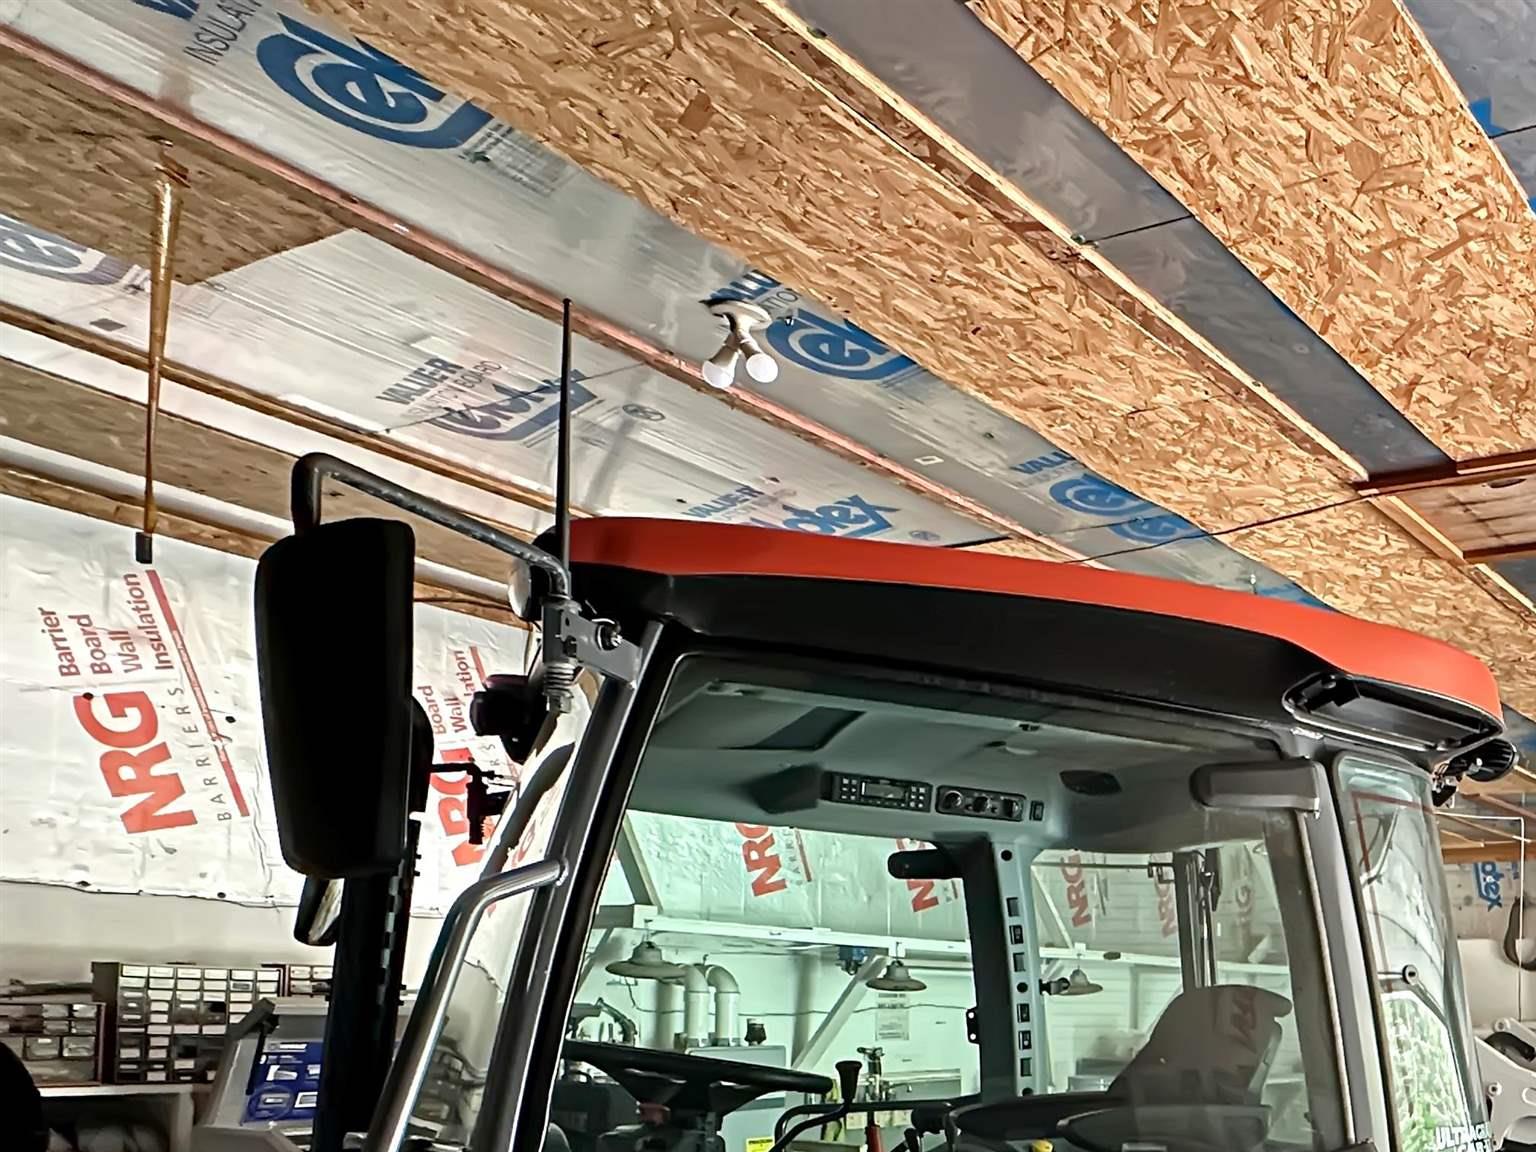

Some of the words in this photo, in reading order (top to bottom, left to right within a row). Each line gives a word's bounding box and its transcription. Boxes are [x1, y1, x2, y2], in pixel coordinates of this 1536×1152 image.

[38, 607, 81, 677] Barrier
[68, 614, 113, 675] Board
[107, 630, 143, 674] Wall
[123, 573, 175, 671] Insulation
[417, 685, 447, 735] Board
[444, 697, 468, 733] Wall
[72, 690, 199, 835] NRG
[167, 686, 234, 822] BARRIERS
